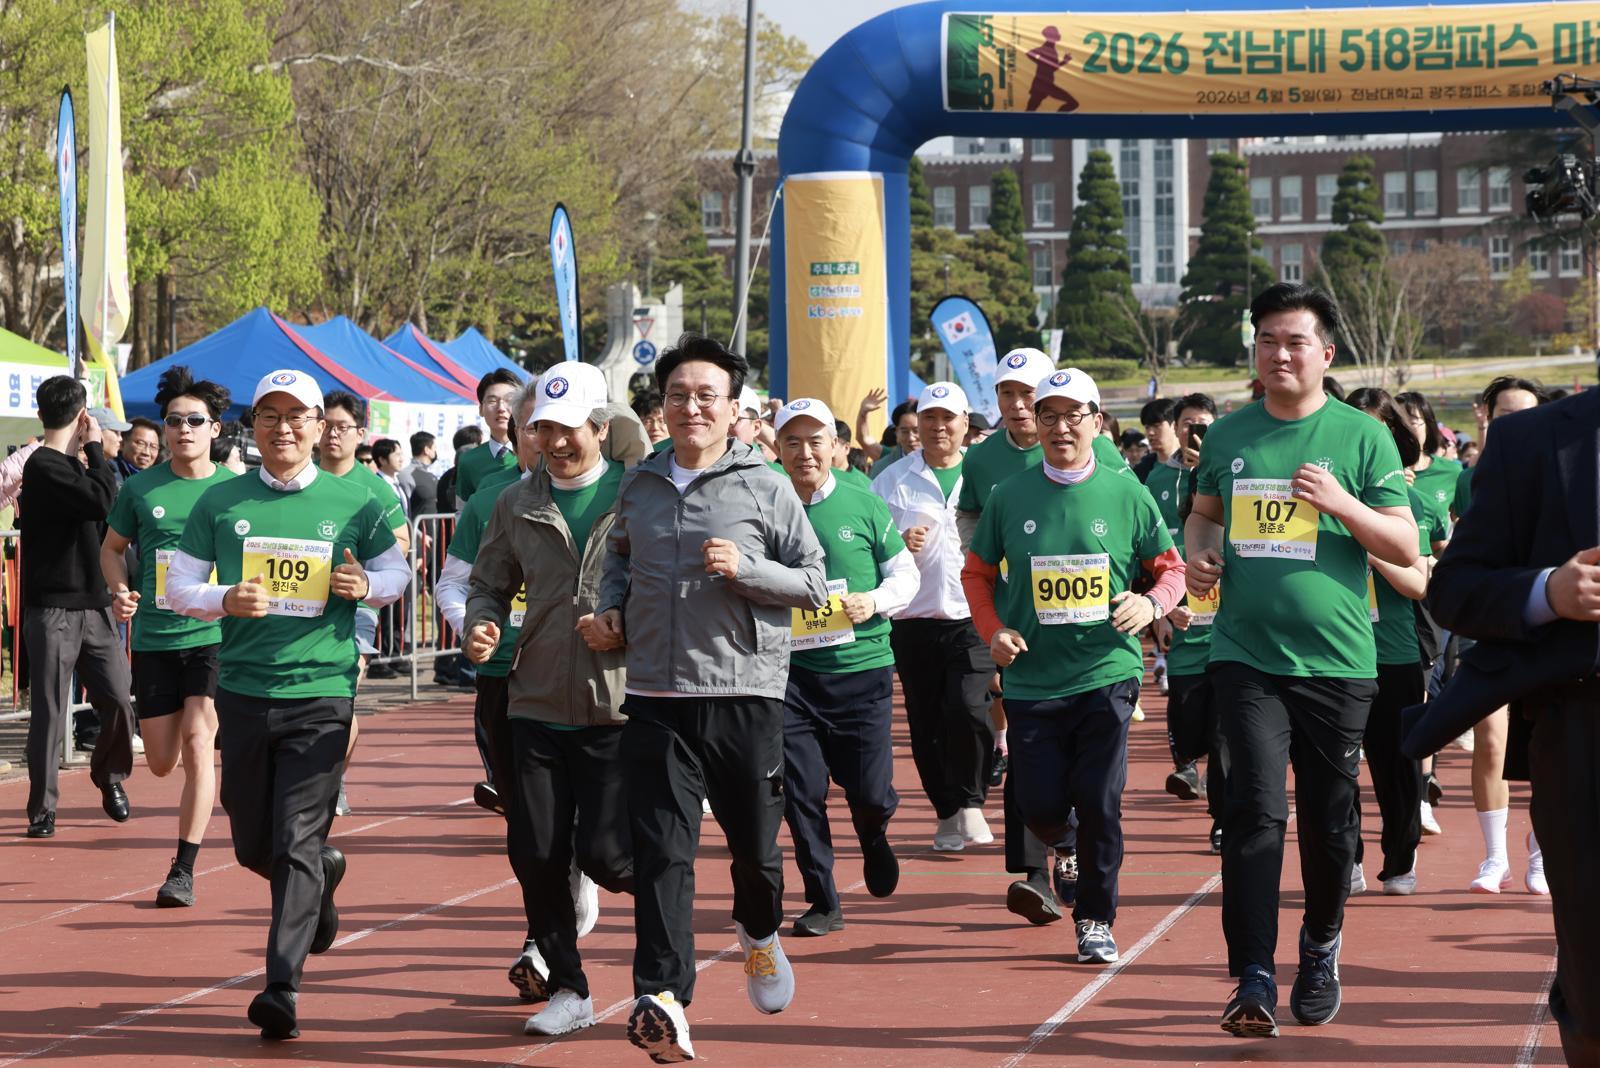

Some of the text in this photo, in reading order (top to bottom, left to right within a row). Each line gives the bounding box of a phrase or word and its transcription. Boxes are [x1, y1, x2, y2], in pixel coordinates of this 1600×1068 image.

[1083, 20, 1600, 75] 2026 전남대 518캠퍼스 마
[1196, 90, 1250, 104] 2026년
[1256, 87, 1283, 104] 4월
[1288, 87, 1342, 104] 5일(일)
[1351, 87, 1424, 101] 전남대학교
[1429, 85, 1503, 99] 광주캠퍼스
[808, 305, 836, 318] kbc
[1253, 500, 1297, 523] 107
[1259, 523, 1286, 534] 정준호
[1271, 544, 1292, 553] kbc
[266, 558, 309, 581] 109
[272, 581, 299, 593] 정진욱
[1038, 576, 1103, 601] 9005
[285, 602, 304, 612] kbc
[1073, 611, 1090, 619] kbc
[806, 619, 827, 630] 양부남
[819, 635, 835, 644] kbc
